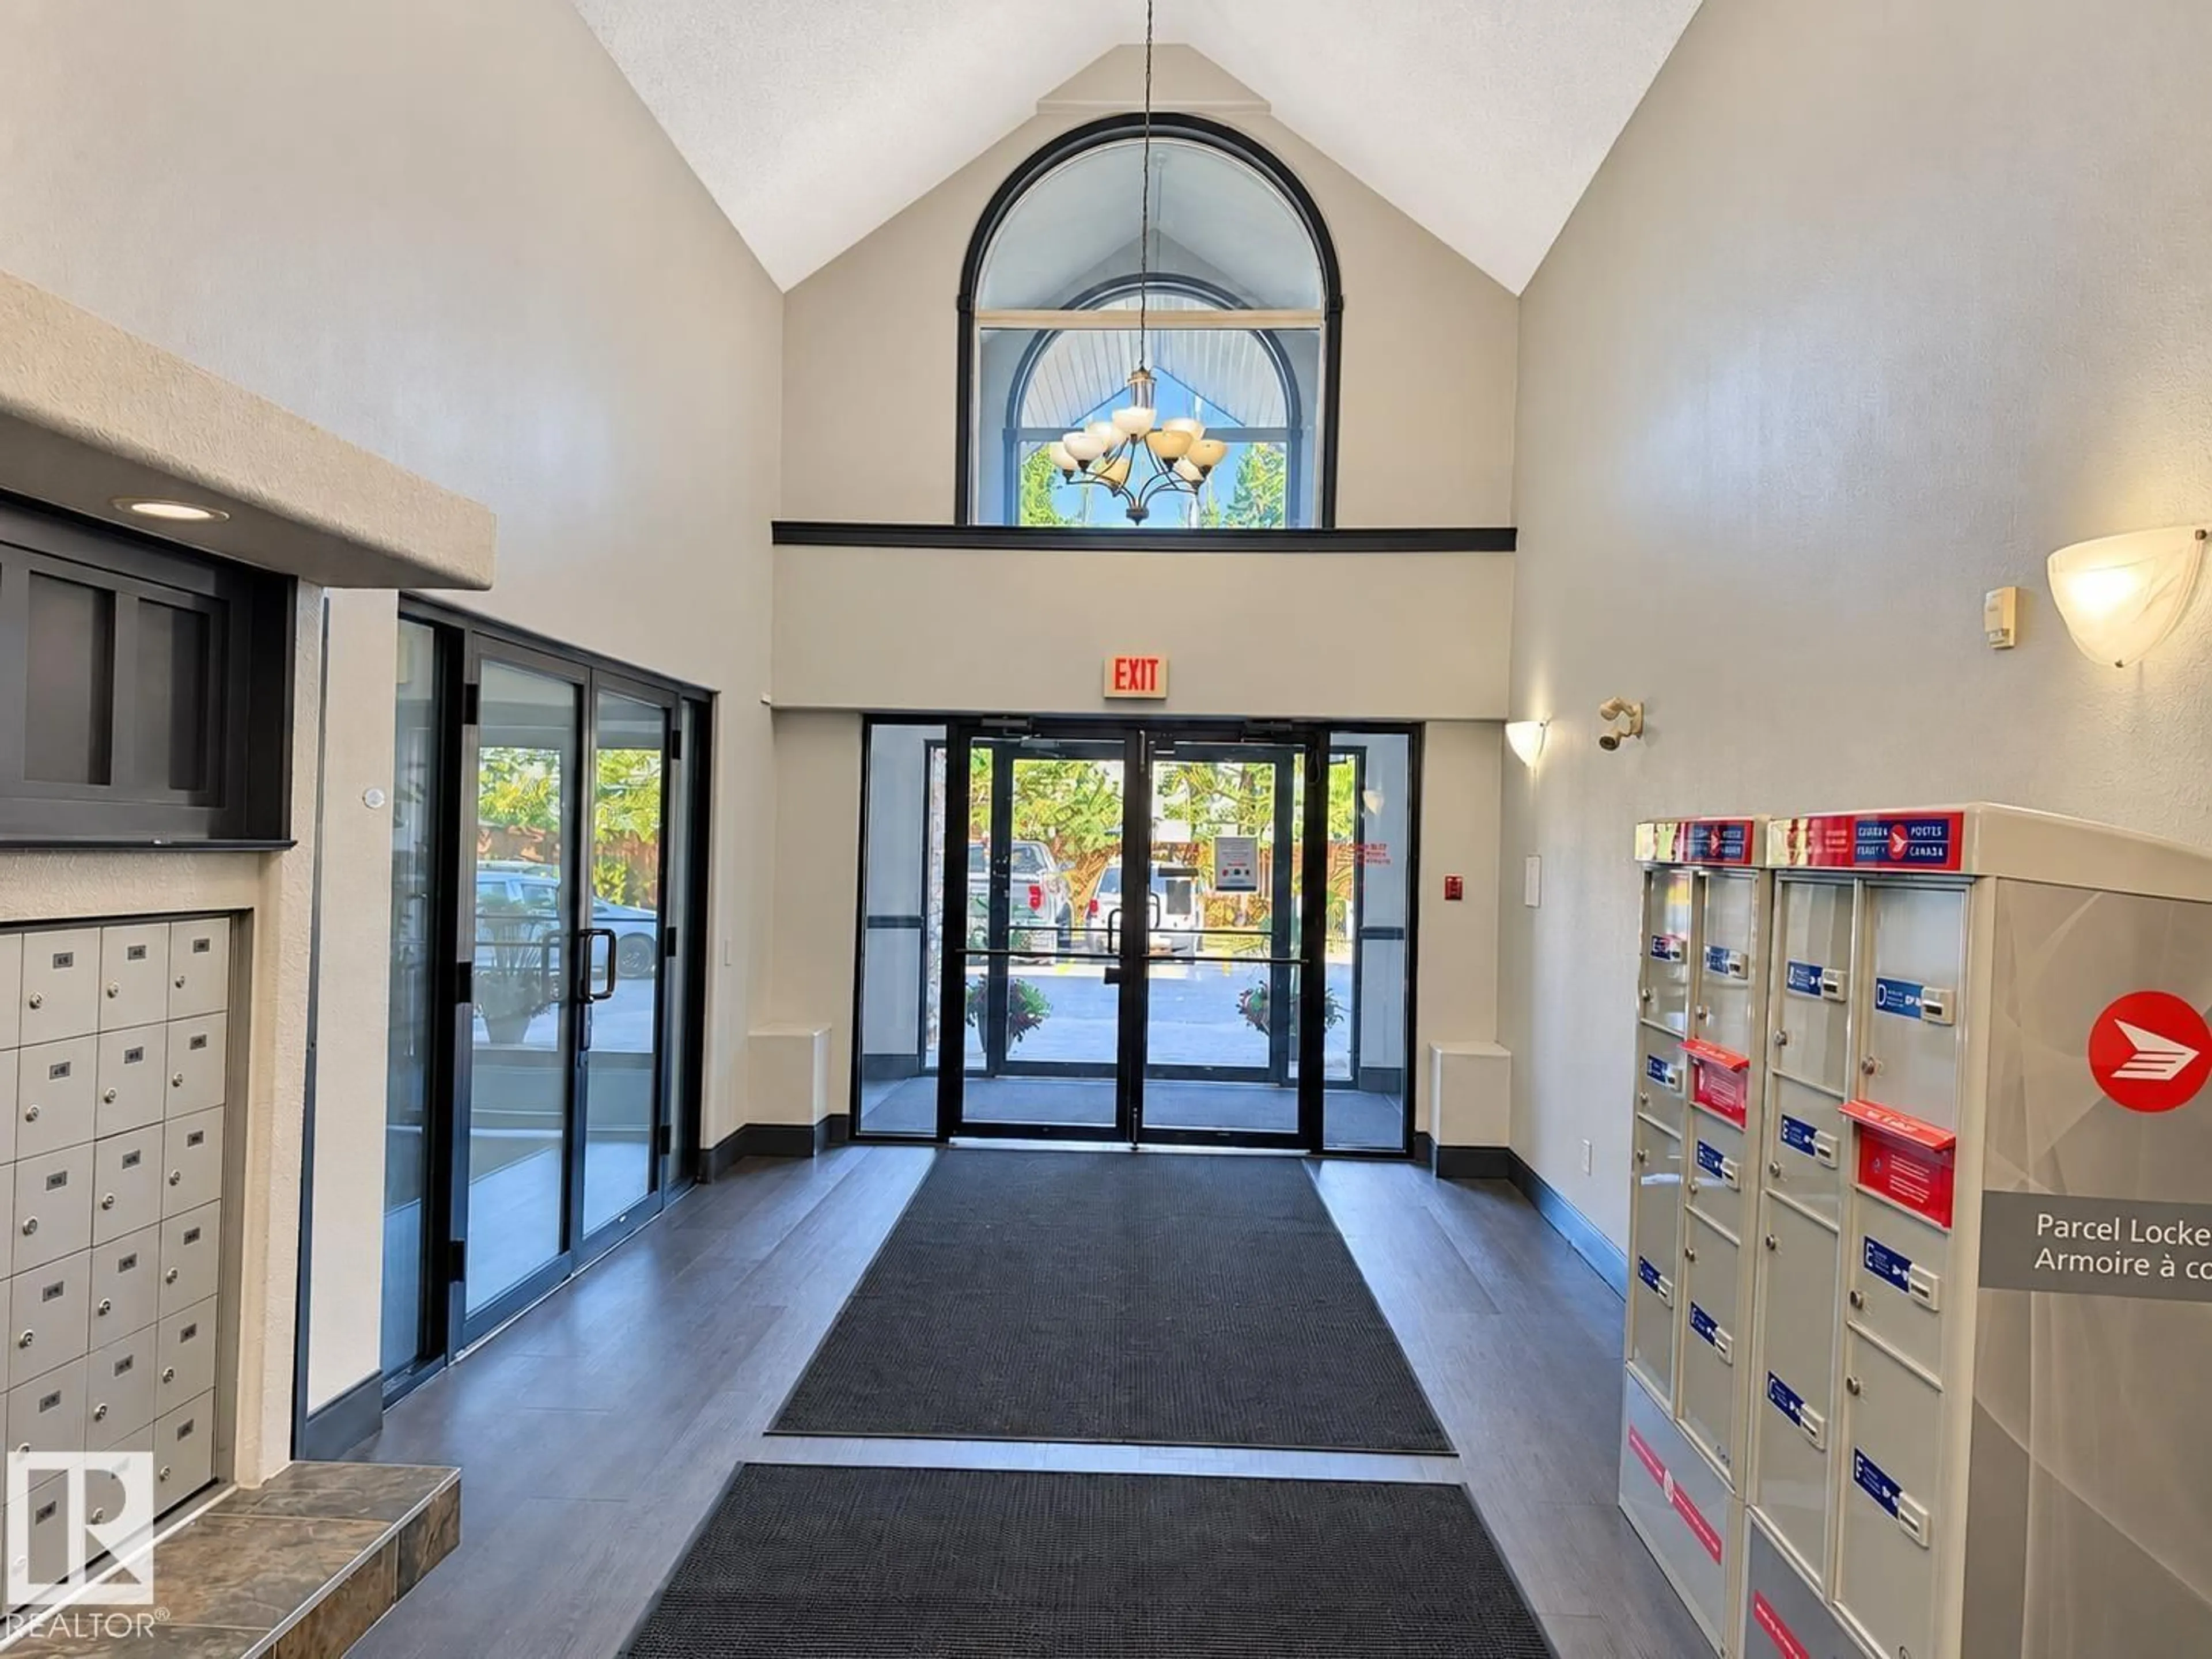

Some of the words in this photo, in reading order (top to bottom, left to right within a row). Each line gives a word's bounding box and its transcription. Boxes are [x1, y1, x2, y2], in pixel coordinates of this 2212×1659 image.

[1115, 658, 1159, 691] EXIT
[2036, 1213, 2120, 1241] Parcel
[2131, 1219, 2211, 1247] Locke
[2034, 1247, 2150, 1276] Armoire
[2160, 1253, 2175, 1278] à
[2186, 1261, 2212, 1279] co
